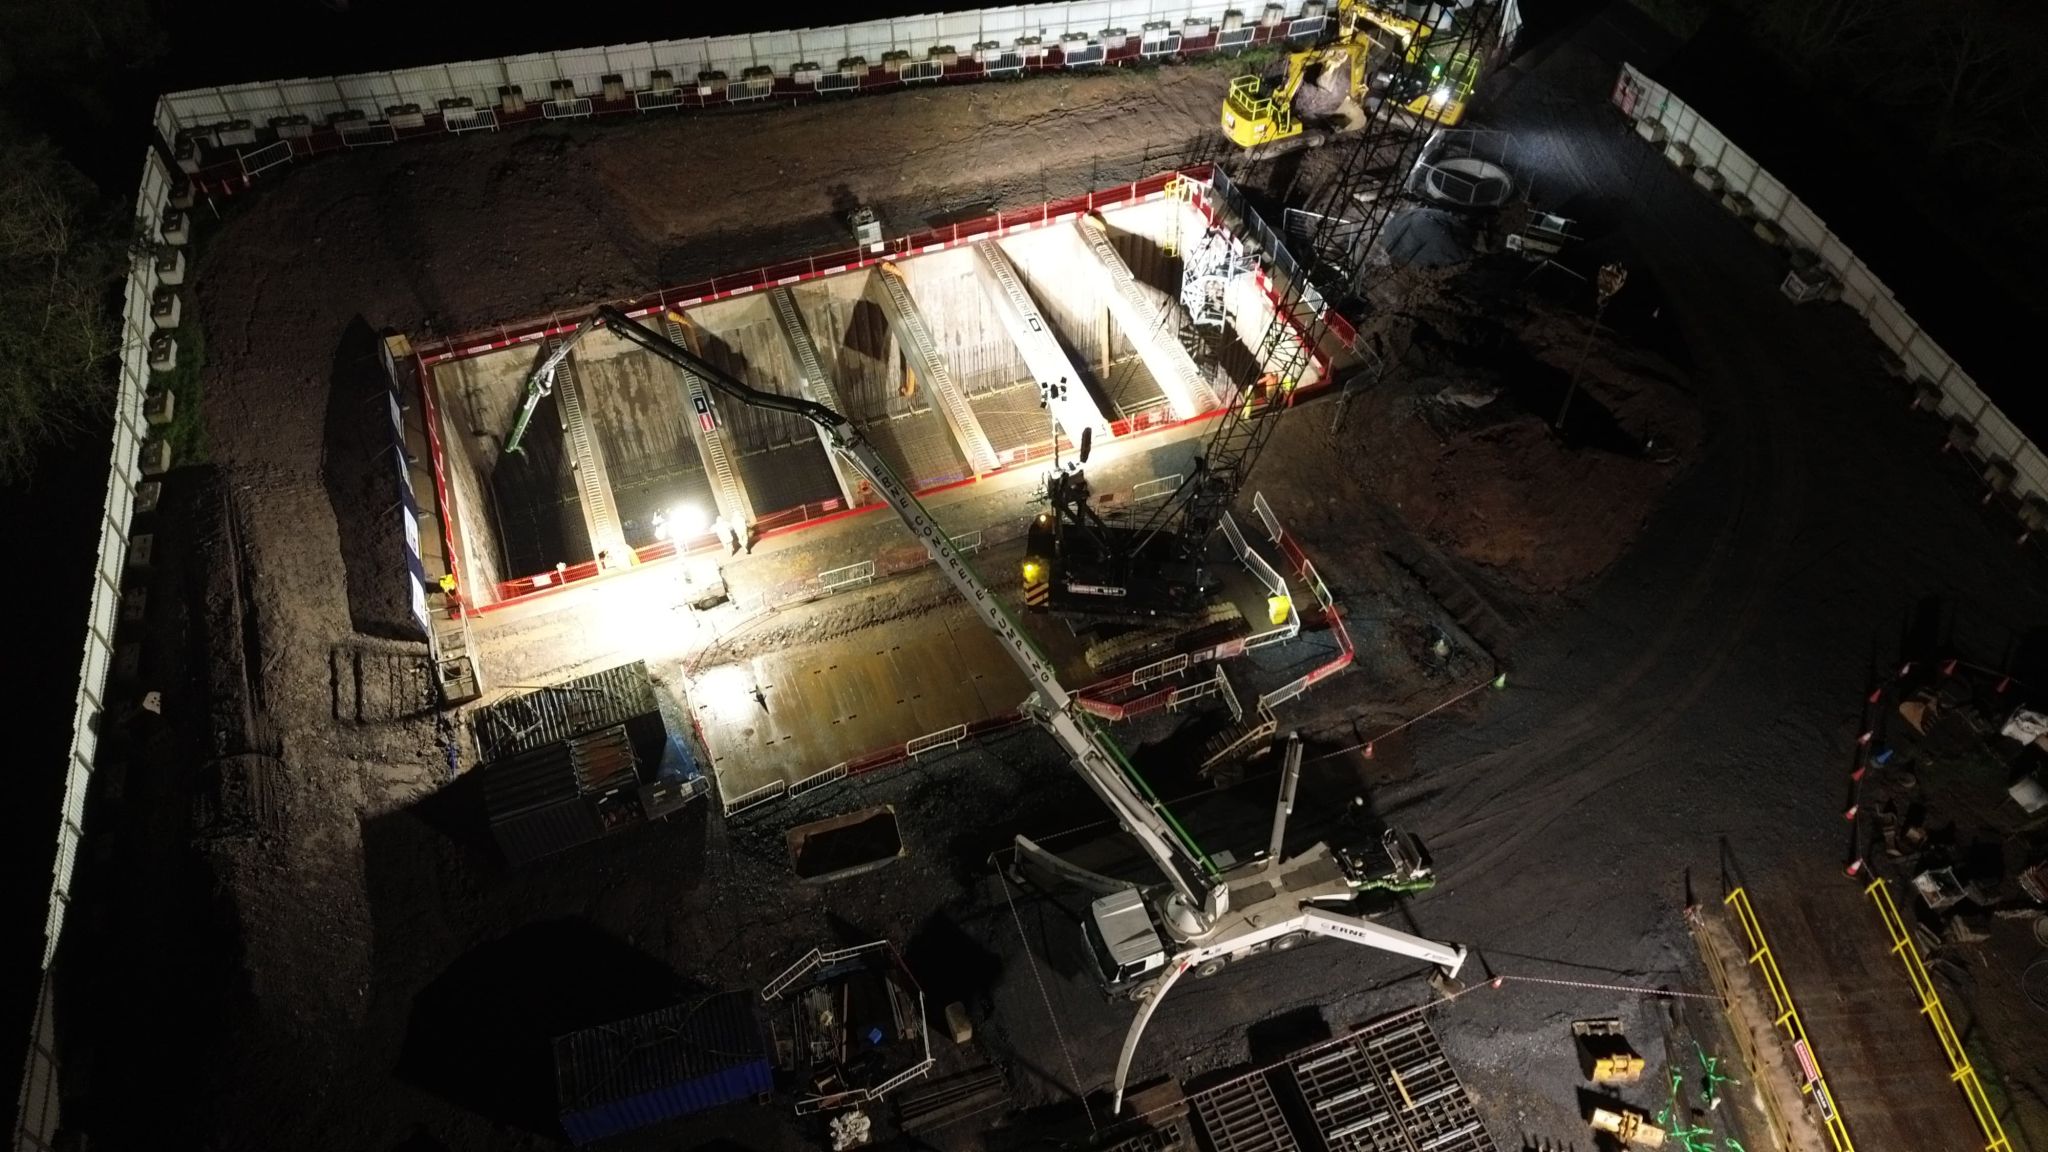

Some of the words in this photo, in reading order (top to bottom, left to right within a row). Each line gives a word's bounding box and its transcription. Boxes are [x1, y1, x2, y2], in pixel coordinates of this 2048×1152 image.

[873, 465, 909, 509] ERNE
[914, 515, 985, 601] CONCRETE
[990, 607, 1050, 683] PUMPING
[1331, 924, 1367, 938] ERNE
